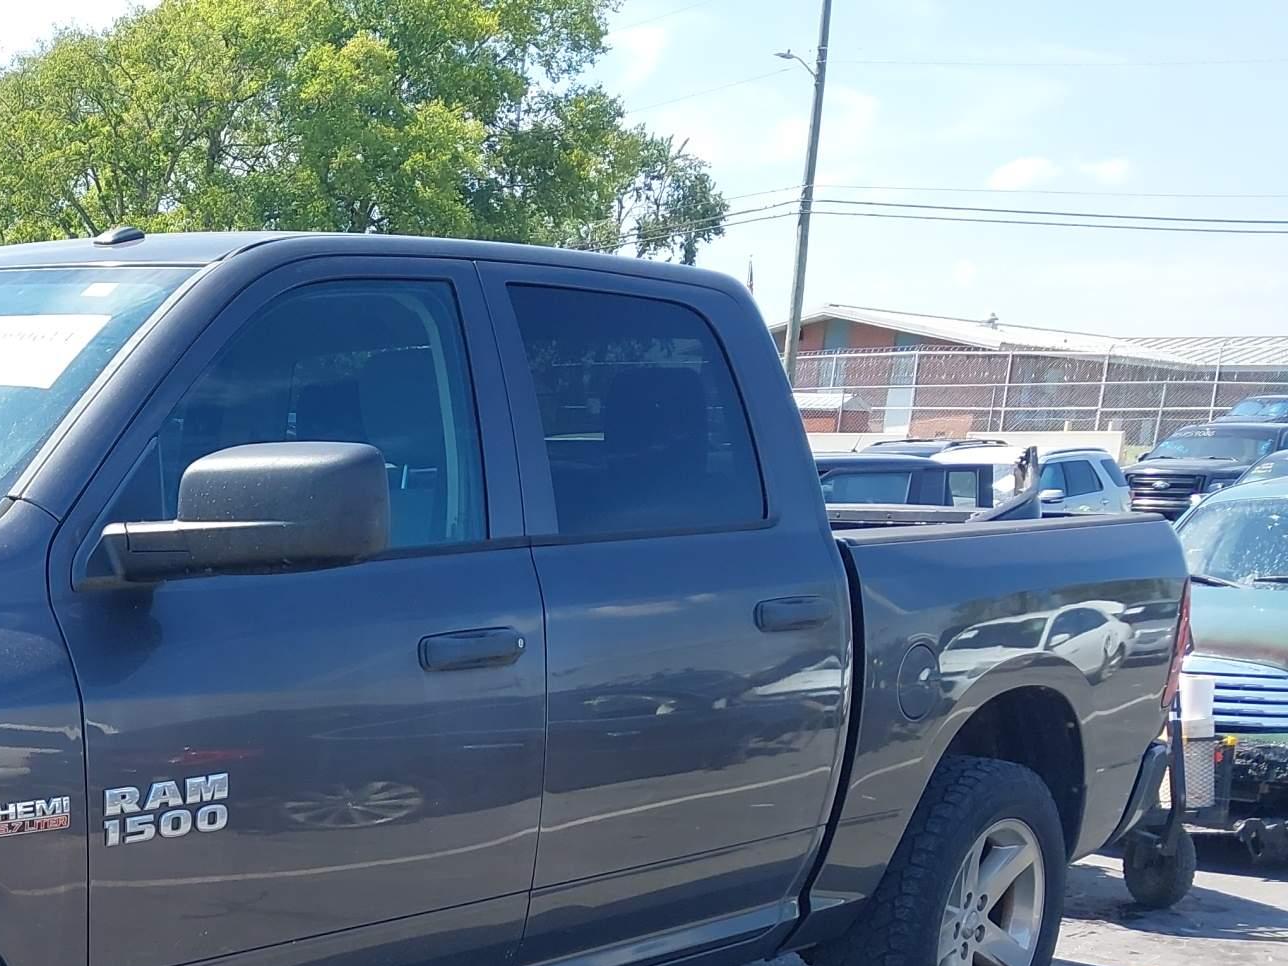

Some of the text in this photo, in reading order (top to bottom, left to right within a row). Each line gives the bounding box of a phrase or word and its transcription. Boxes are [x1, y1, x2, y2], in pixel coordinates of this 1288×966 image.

[104, 773, 229, 816] RAM
[25, 815, 67, 832] LITER
[104, 804, 229, 847] 1500
